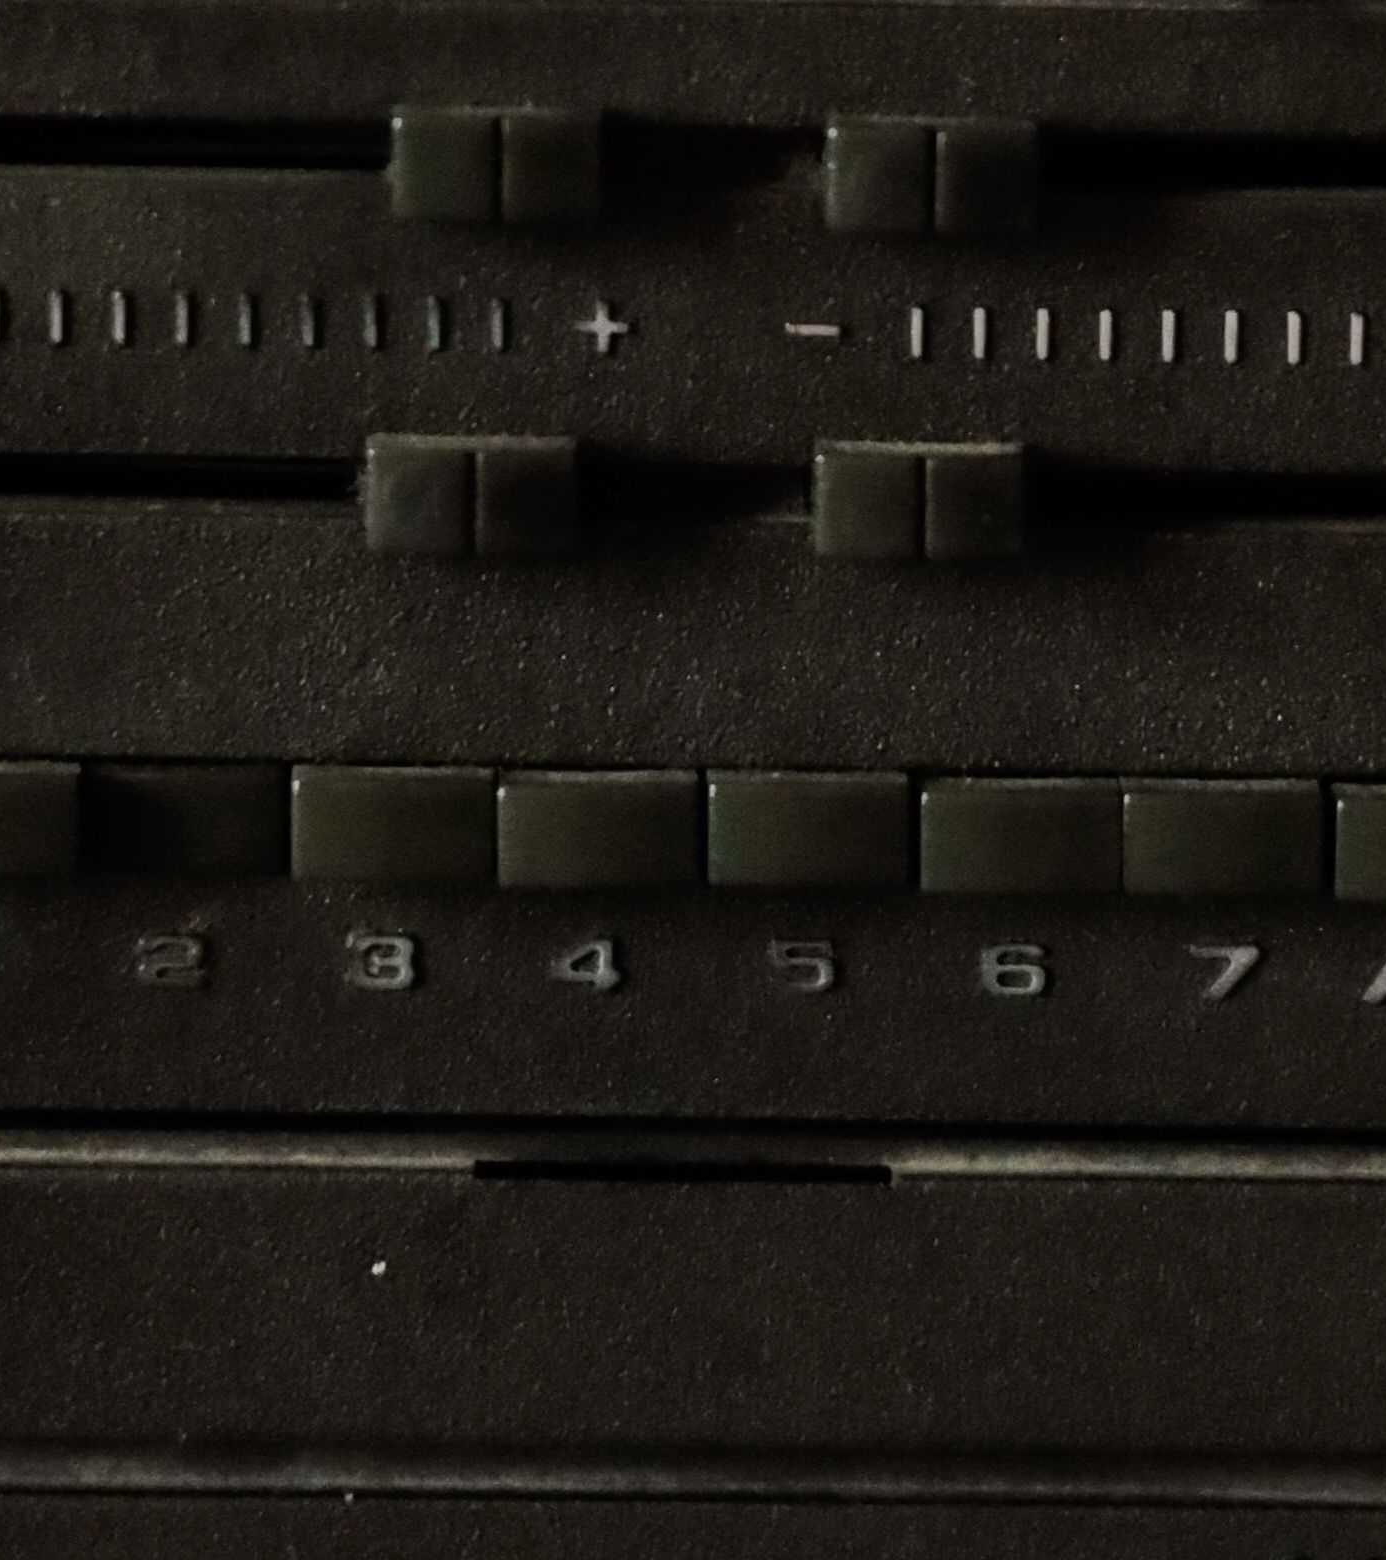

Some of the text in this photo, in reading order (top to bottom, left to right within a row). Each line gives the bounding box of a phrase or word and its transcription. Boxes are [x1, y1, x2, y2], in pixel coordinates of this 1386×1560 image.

[136, 933, 205, 987] 2
[346, 932, 415, 990] 3
[553, 937, 620, 992] 4
[766, 938, 835, 993] 5
[980, 943, 1048, 997] 6
[1190, 943, 1261, 1001] 7
